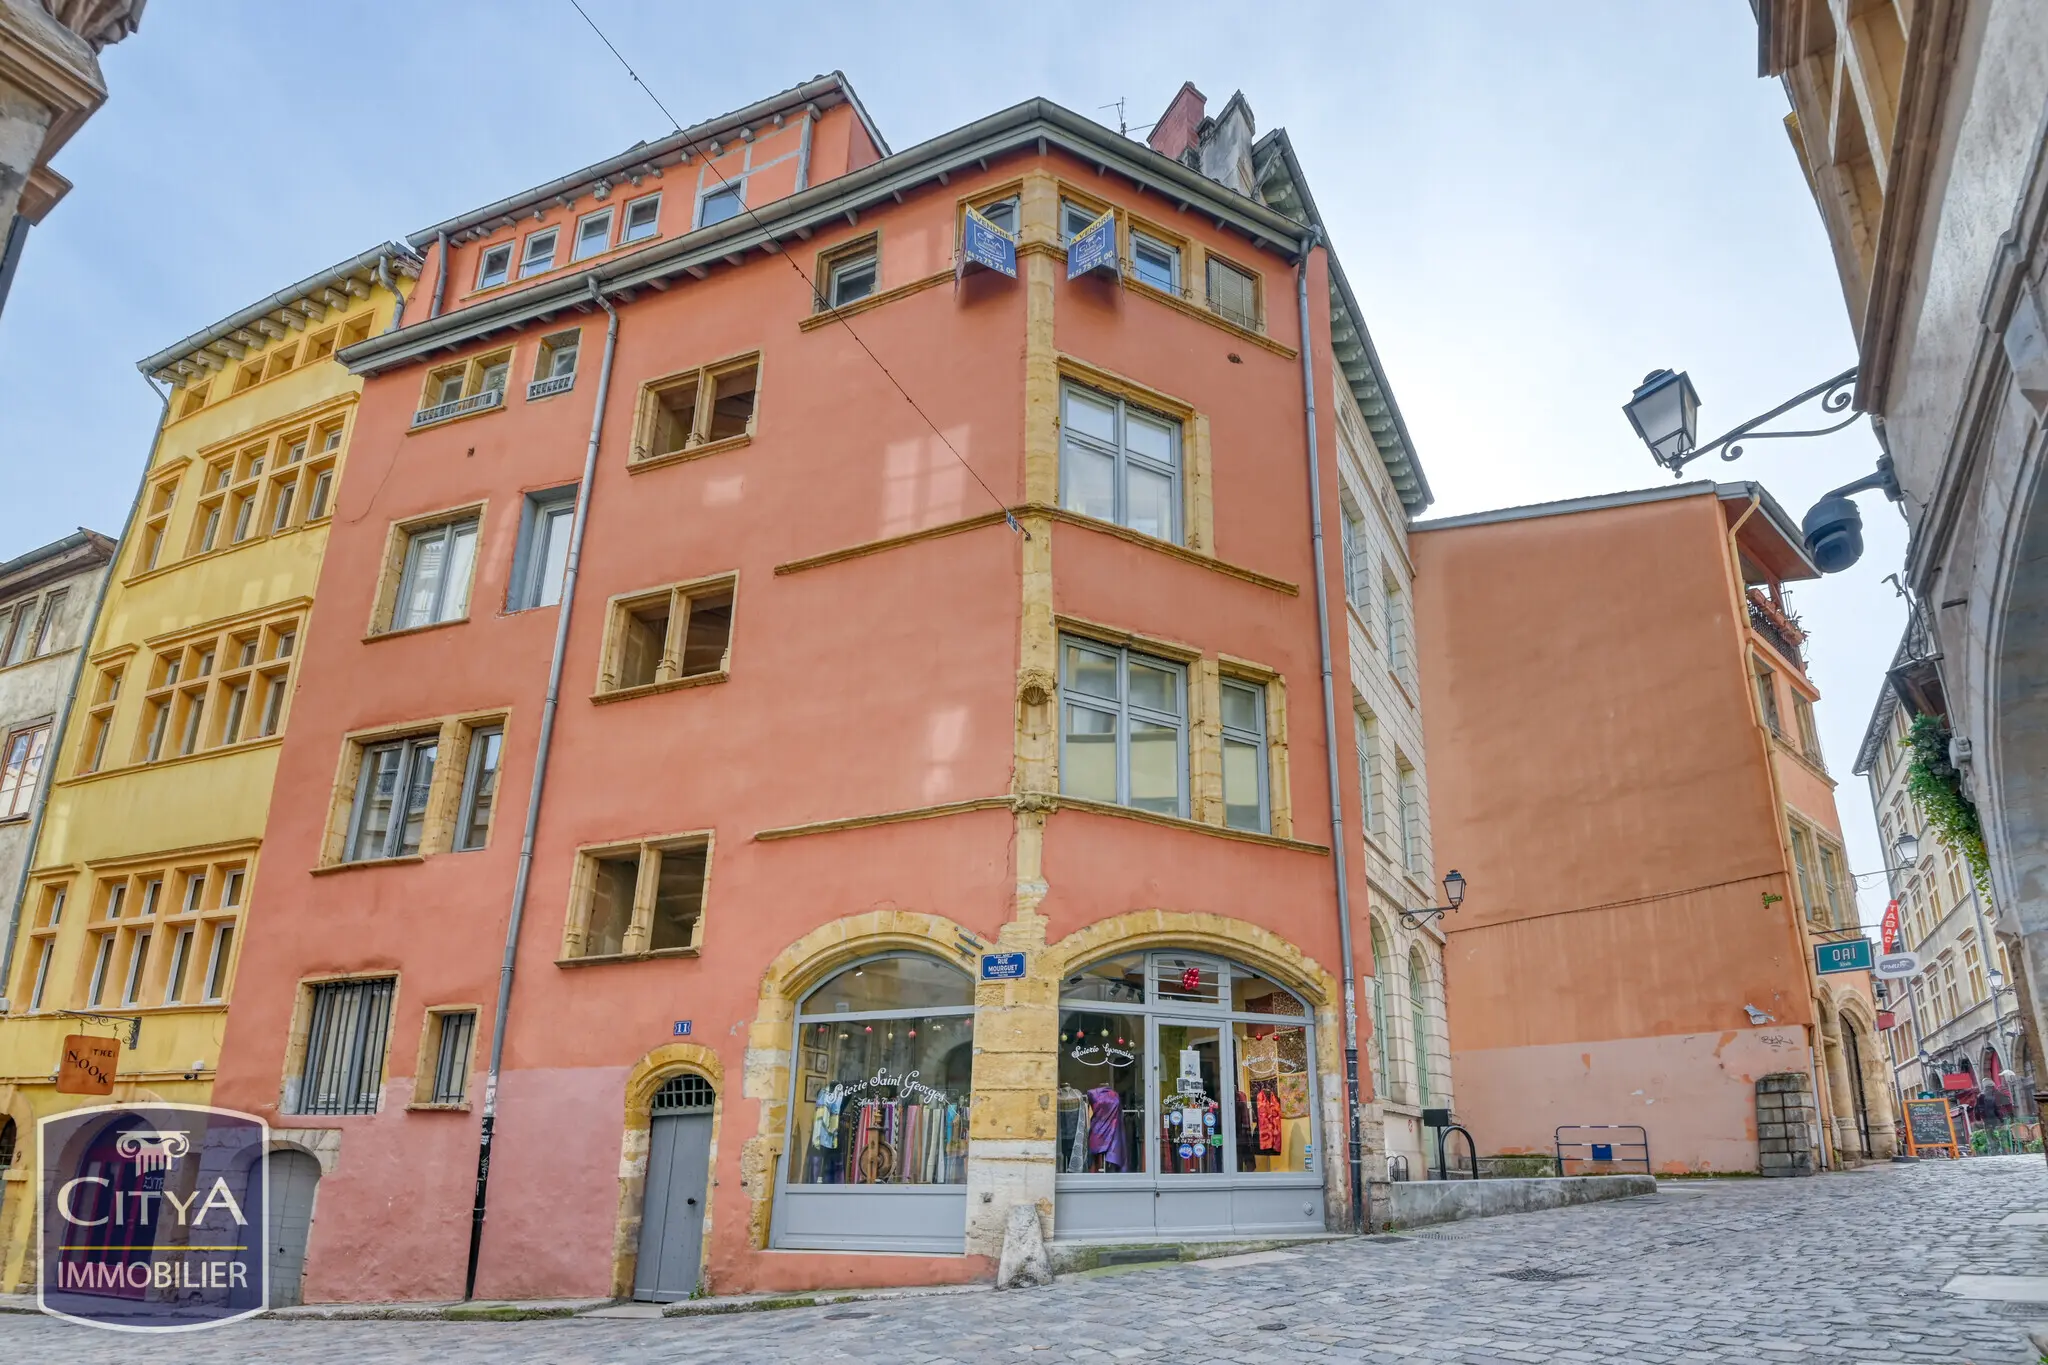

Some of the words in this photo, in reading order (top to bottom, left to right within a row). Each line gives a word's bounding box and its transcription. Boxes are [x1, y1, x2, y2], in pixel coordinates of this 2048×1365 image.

[976, 215, 1010, 239] VENDRE
[1079, 211, 1112, 238] VENDRE
[985, 257, 993, 267] 75
[995, 262, 1005, 272] 71
[1006, 267, 1016, 276] 00
[1093, 257, 1102, 266] 71
[1104, 250, 1113, 260] 00
[1884, 904, 1898, 943] TABAC
[988, 964, 1018, 972] MOURGUET
[678, 1023, 687, 1033] 11
[93, 1048, 113, 1058] THE
[1071, 1045, 1099, 1058] Soierie
[67, 1049, 108, 1085] NOOK
[826, 1080, 867, 1103] Soierie
[869, 1067, 902, 1087] Saint
[900, 1070, 946, 1104] Georges
[16, 1151, 22, 1163] 9
